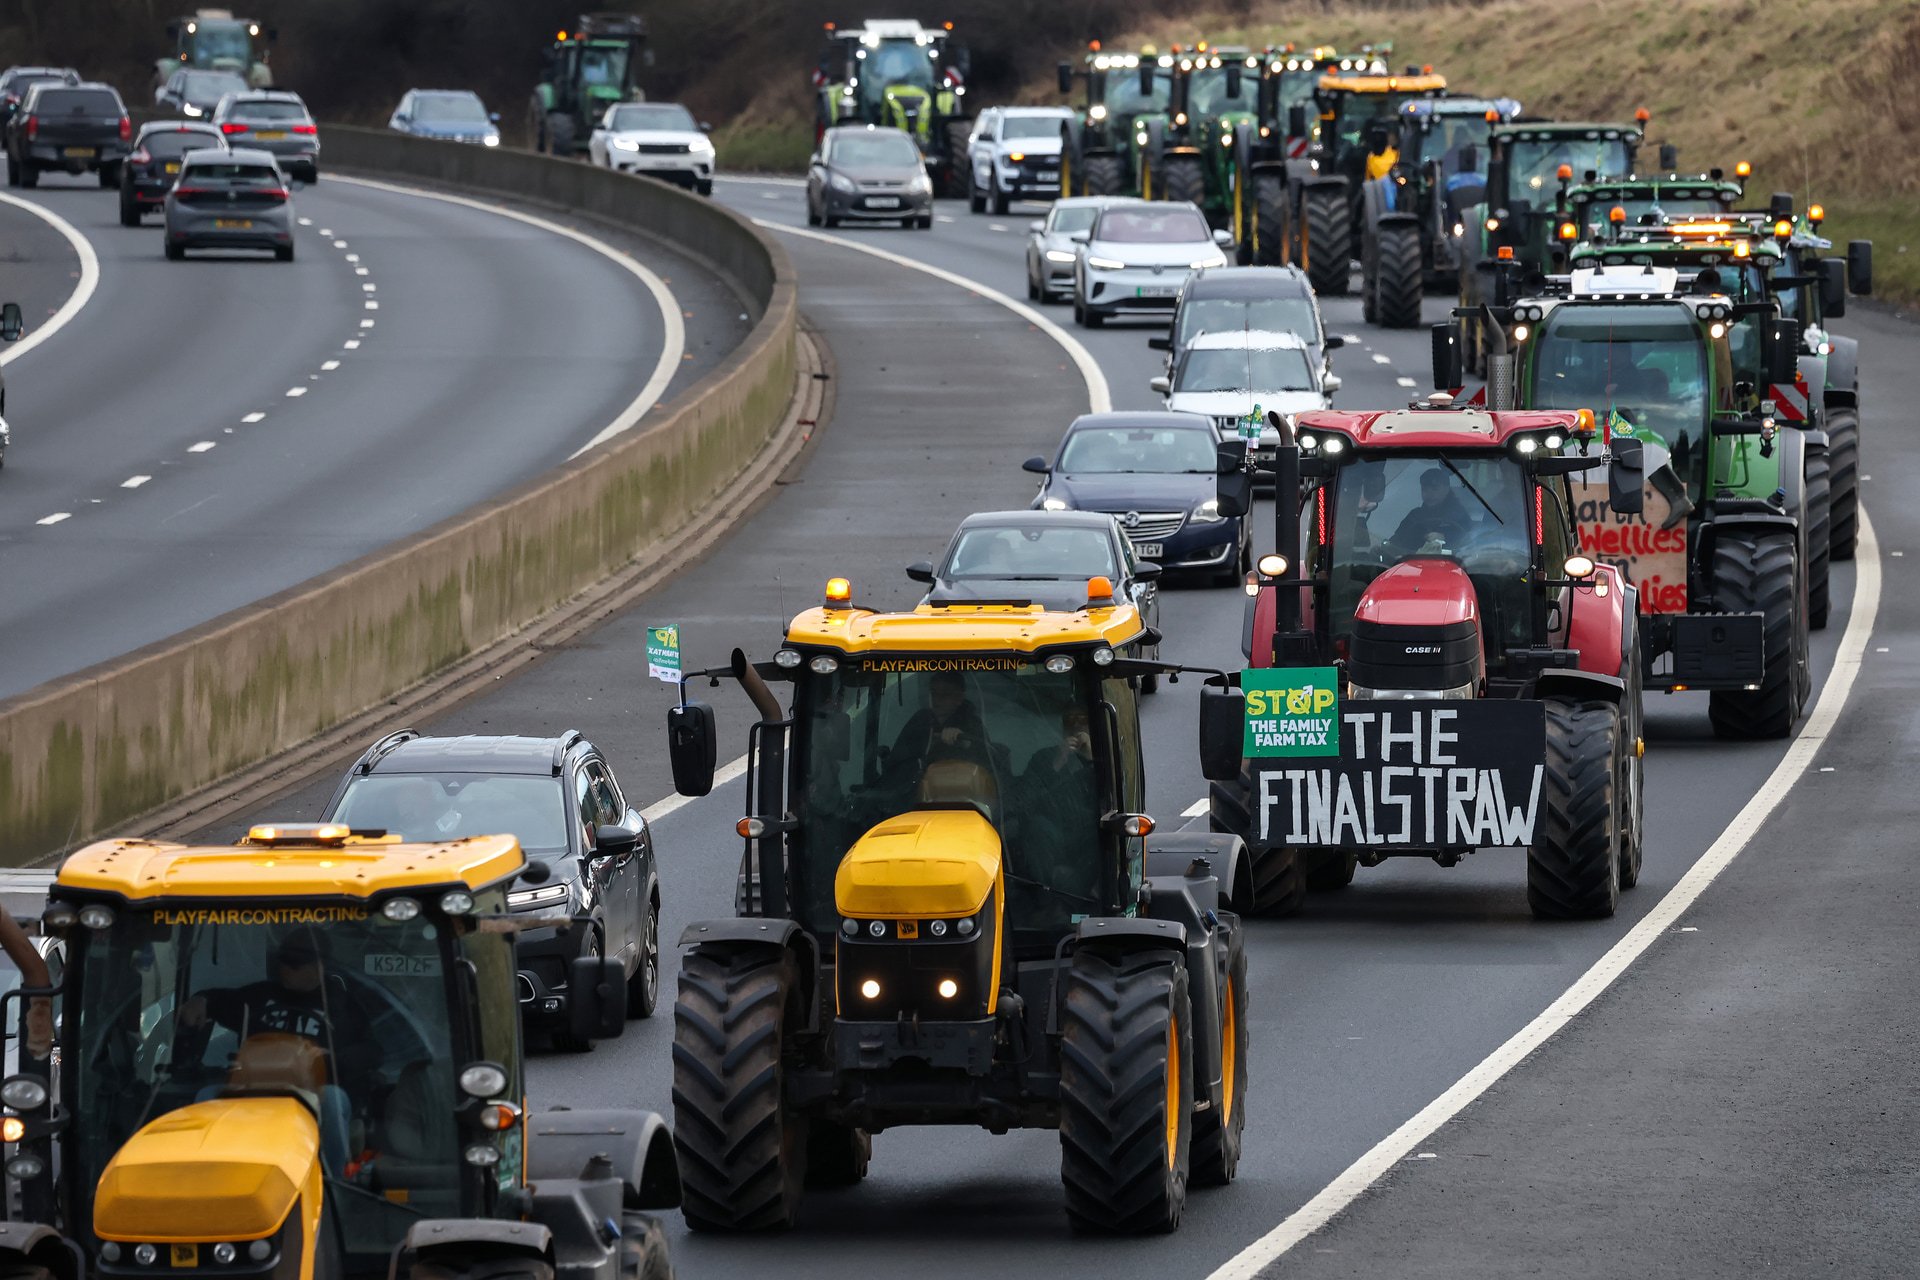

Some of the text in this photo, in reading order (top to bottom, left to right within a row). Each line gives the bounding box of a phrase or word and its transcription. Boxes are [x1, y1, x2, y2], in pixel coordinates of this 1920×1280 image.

[1578, 523, 1686, 555] Wellies
[1140, 545, 1160, 555] TGV
[1405, 646, 1431, 654] CASE
[1246, 686, 1334, 716] STOP
[1249, 718, 1332, 733] THE FAMILY
[1255, 732, 1327, 746] FARM TAX
[1343, 709, 1458, 765] THE
